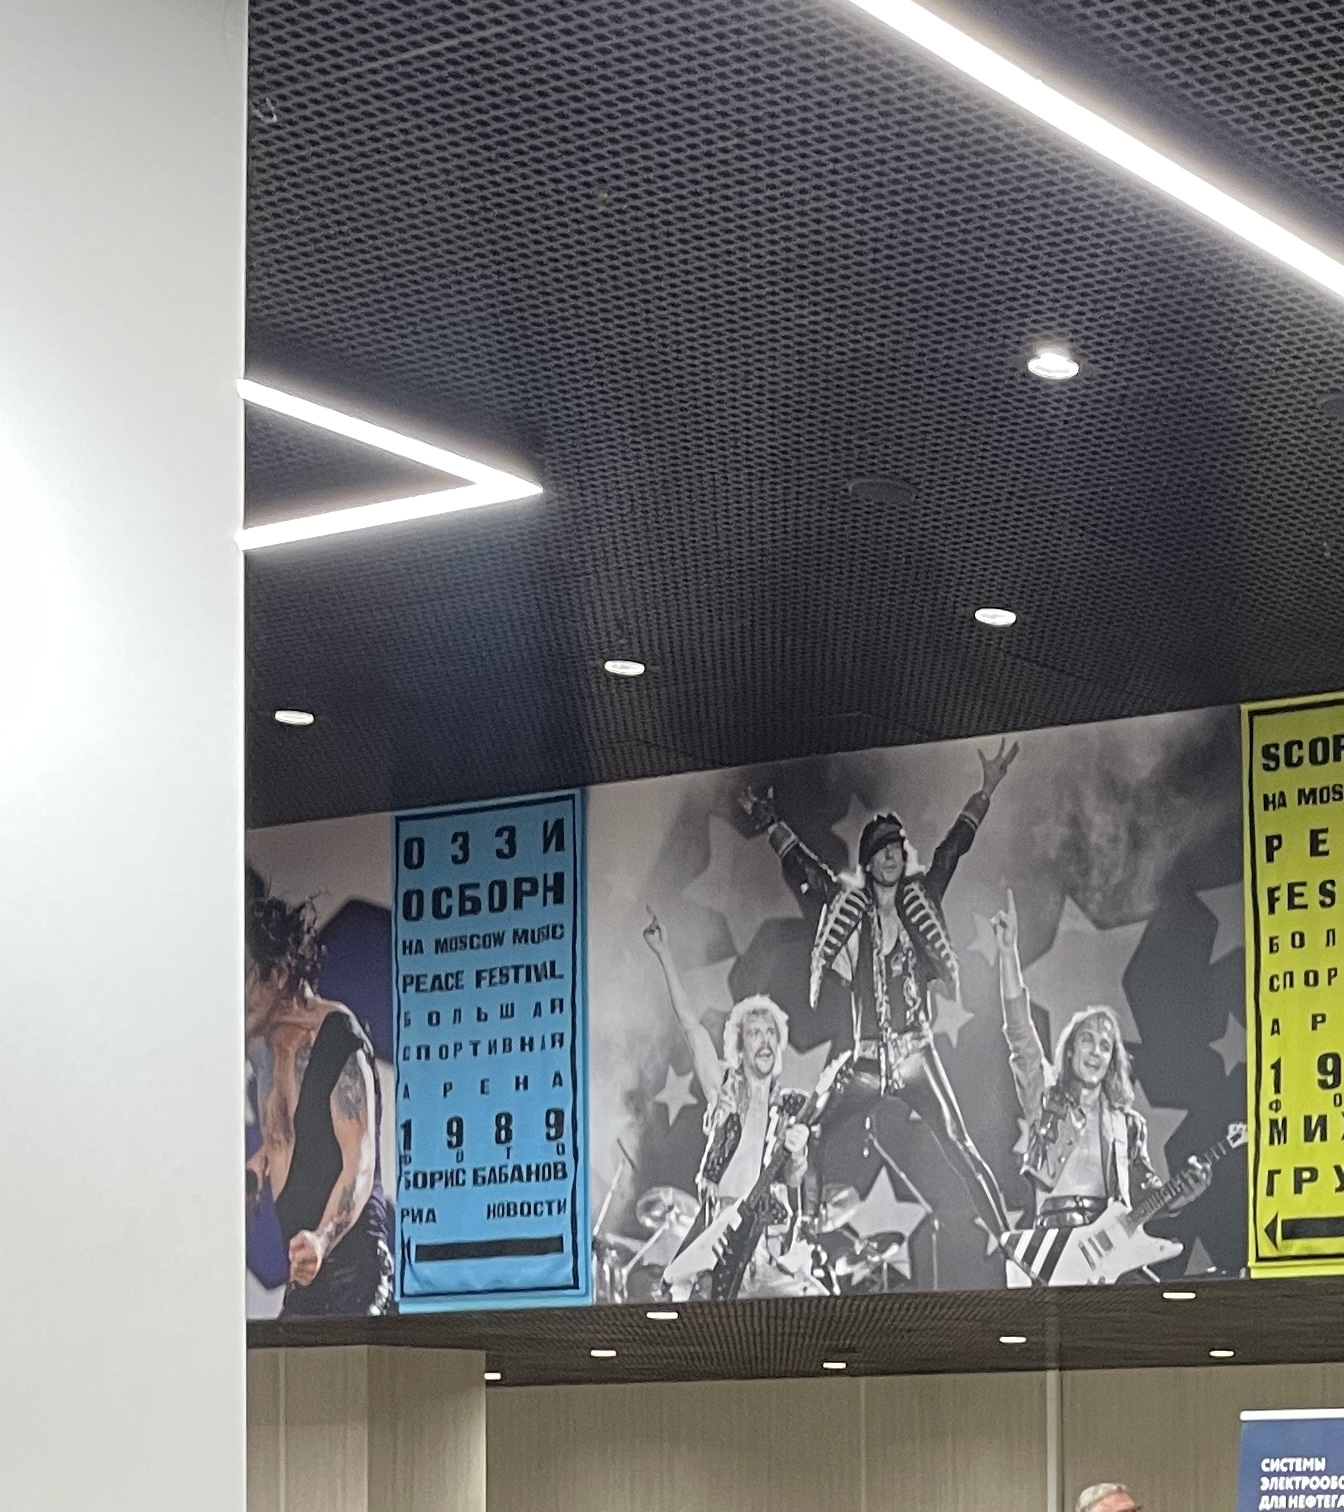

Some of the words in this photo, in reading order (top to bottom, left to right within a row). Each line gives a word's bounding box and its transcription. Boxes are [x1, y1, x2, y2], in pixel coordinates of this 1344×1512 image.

[1262, 789, 1288, 813] НА
[403, 817, 566, 871] ОЗЗИ
[402, 871, 566, 922] ОСБОРН
[402, 939, 425, 956] НА
[434, 930, 506, 955] MOSCOW
[402, 969, 465, 994] PEACE
[475, 960, 564, 989] FESTIVAL
[403, 997, 565, 1028] БОЛЬШАЯ
[402, 1031, 565, 1062] СПОРТИВНАЯ
[402, 1069, 564, 1101] АРЕНА
[400, 1107, 565, 1151] 1989
[472, 1160, 568, 1187] БАБАНОВ
[400, 1207, 437, 1225] РИА
[486, 1197, 567, 1220] НОВОСТИ
[1260, 1457, 1326, 1473] СИСТЕМЫ
[1258, 1495, 1287, 1511] ДЛЯ
